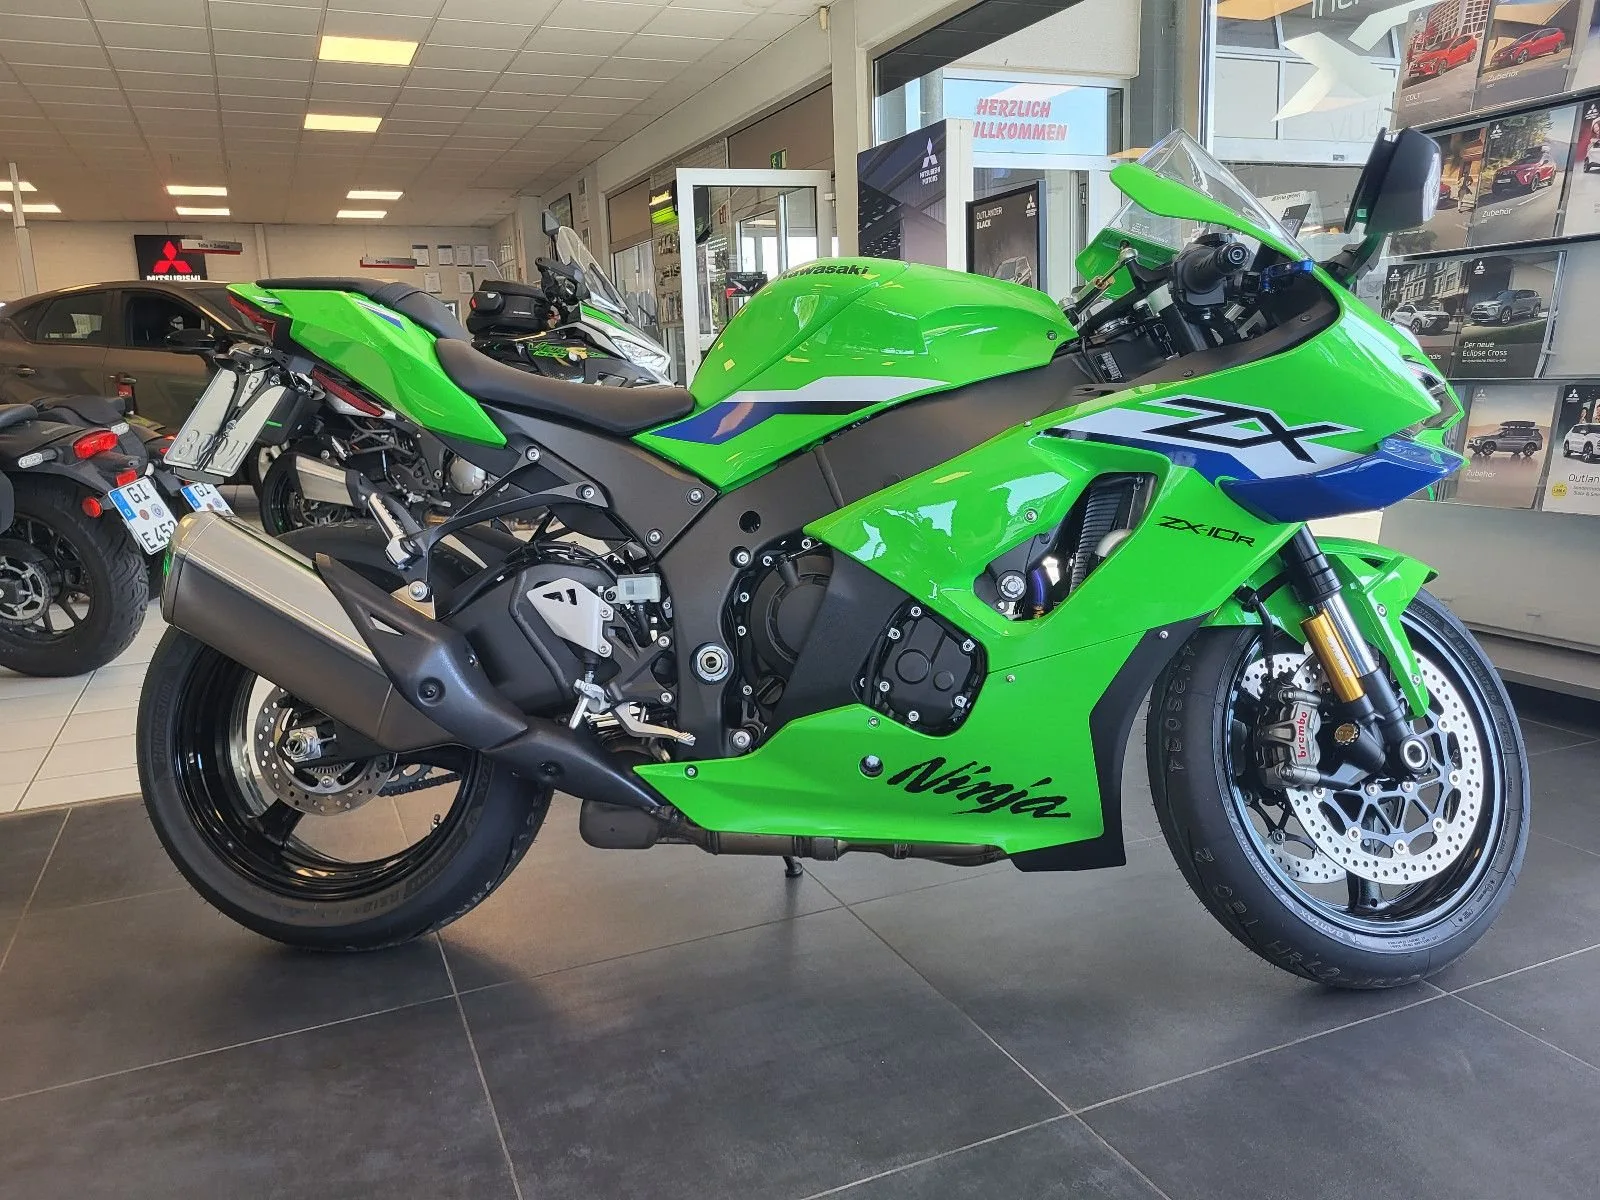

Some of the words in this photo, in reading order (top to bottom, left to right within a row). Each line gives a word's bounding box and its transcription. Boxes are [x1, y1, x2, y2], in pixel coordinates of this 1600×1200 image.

[976, 98, 1052, 118] HERZLICH
[973, 121, 1067, 141] ILLKOMMEN
[976, 206, 1003, 220] OUTLANDER
[976, 220, 992, 230] BLACK
[1568, 473, 1600, 482] Outlan
[126, 484, 150, 504] GI
[141, 533, 158, 549] E
[1155, 516, 1256, 548] ZX-10R
[1298, 711, 1308, 758] brembo
[887, 756, 1072, 818] Ninja
[1300, 909, 1345, 940] BATTLAX
